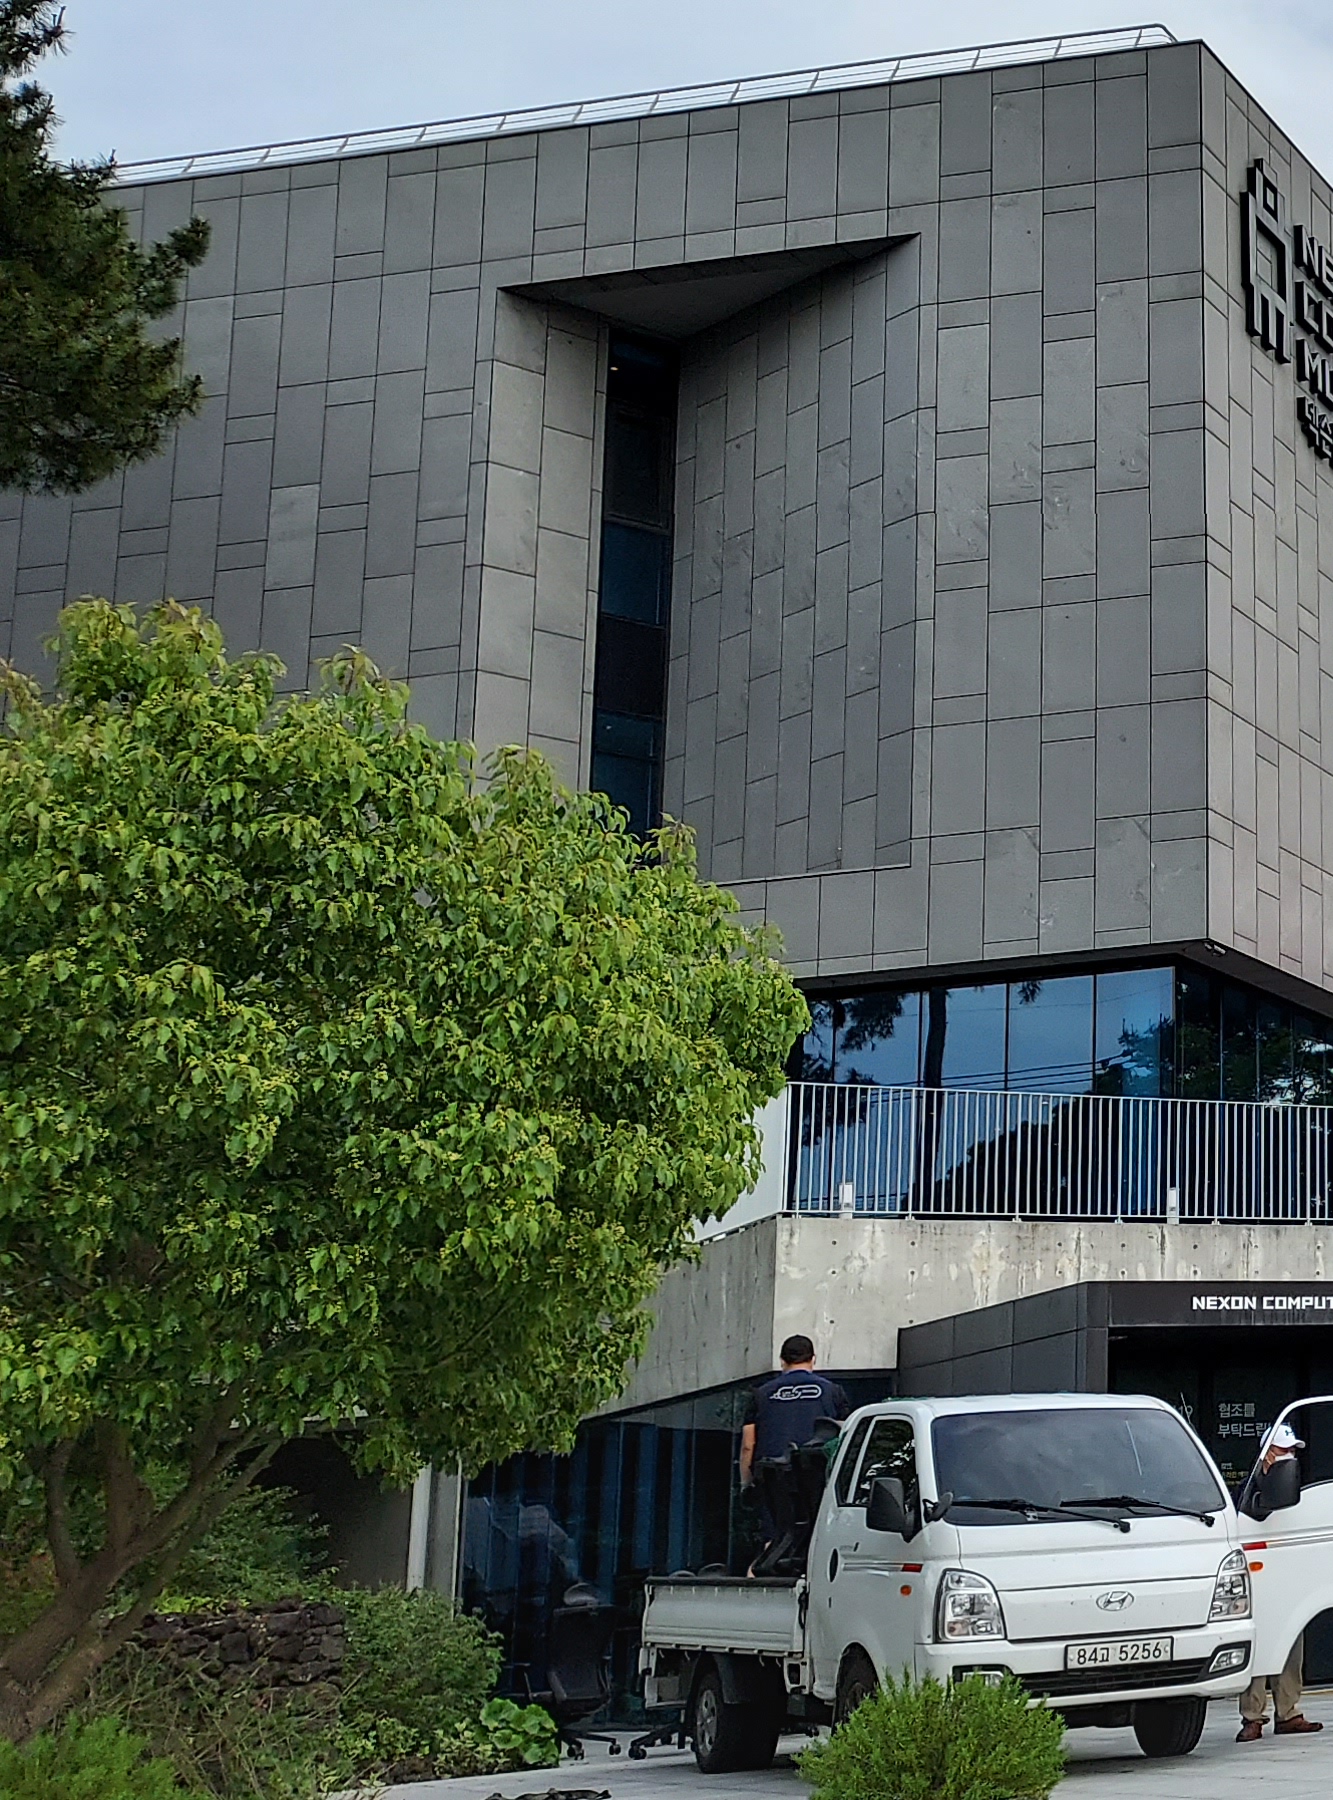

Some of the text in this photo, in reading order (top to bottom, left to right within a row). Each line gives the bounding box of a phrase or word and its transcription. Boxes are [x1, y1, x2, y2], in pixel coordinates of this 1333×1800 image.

[1192, 1296, 1257, 1310] NEXON
[1218, 1402, 1255, 1418] 협조를
[1077, 1641, 1162, 1665] 84고 5256
